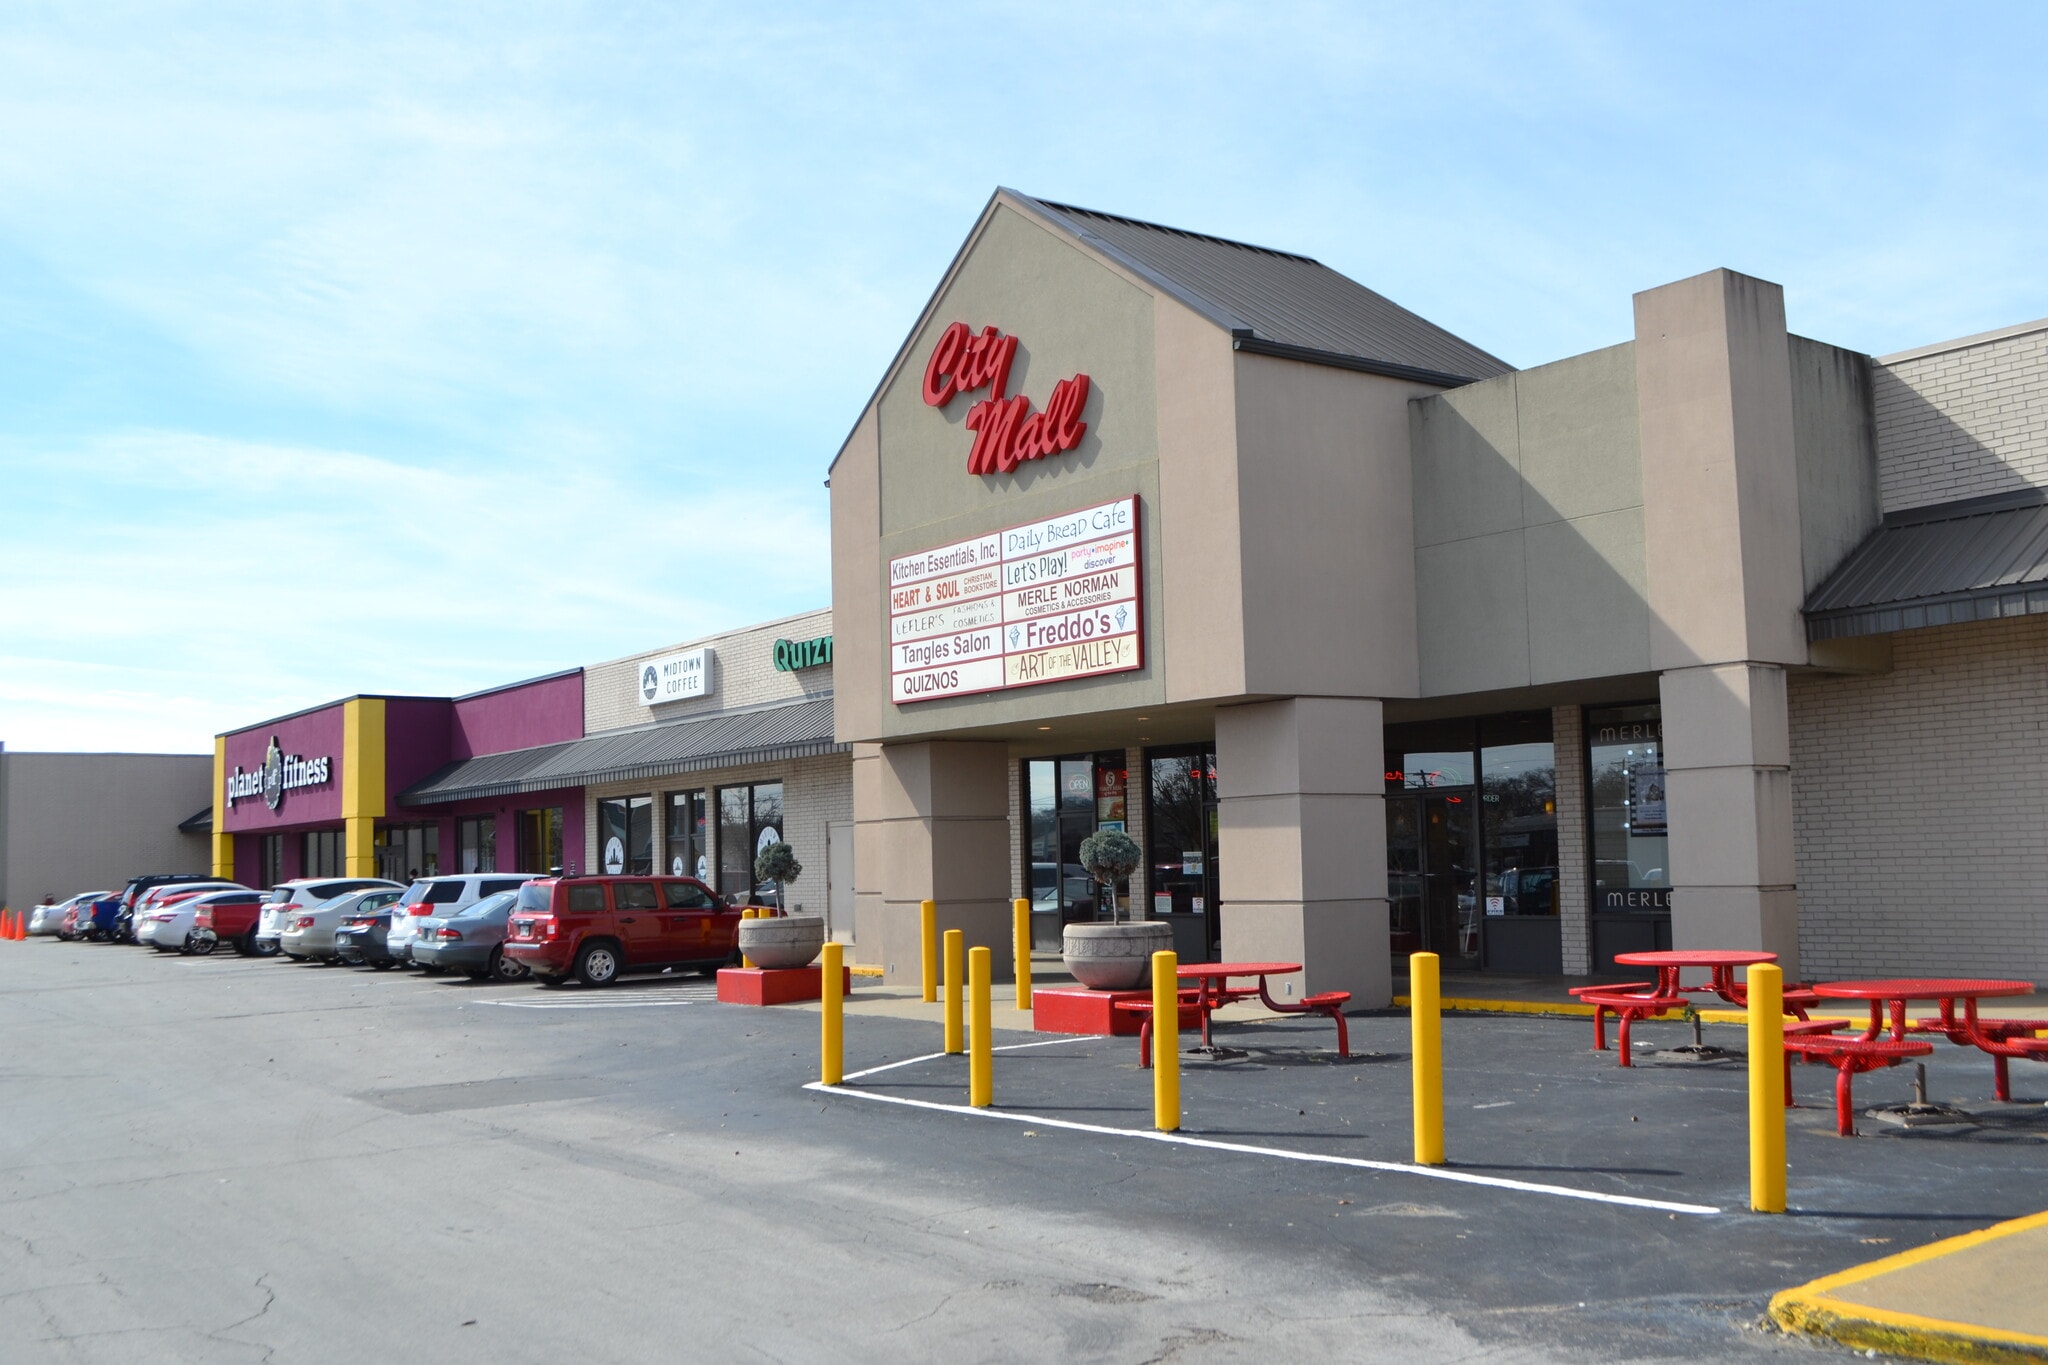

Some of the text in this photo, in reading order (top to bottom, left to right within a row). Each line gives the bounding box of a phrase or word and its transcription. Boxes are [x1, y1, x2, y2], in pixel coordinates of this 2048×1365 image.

[922, 321, 1018, 407] City
[966, 373, 1090, 475] Mall
[892, 542, 998, 580] Kitchen Essentials, Inc.
[1007, 552, 1067, 585] Let's Play!
[1083, 555, 1116, 570] discover
[963, 572, 993, 585] CHRISTIAN
[963, 579, 998, 594] BOOKSTORE
[1018, 572, 1119, 608] MERLE NORMAN
[893, 580, 960, 609] HEART & SOUL
[1025, 591, 1112, 616] COSMETICS & ACCESSORIES
[896, 613, 945, 636] LEFLER'S
[953, 613, 995, 628] COSMETICS
[1027, 609, 1111, 648] Freddo's
[902, 633, 991, 666] Tangles Salon
[1019, 638, 1122, 680] ART OF THE VALLEY
[663, 656, 701, 677] MIDTOWN
[666, 675, 698, 694] COFFEE
[903, 670, 958, 695] QUIZNOS
[227, 763, 263, 808] planet
[283, 754, 328, 789] fitness
[1069, 779, 1089, 790] OPEN
